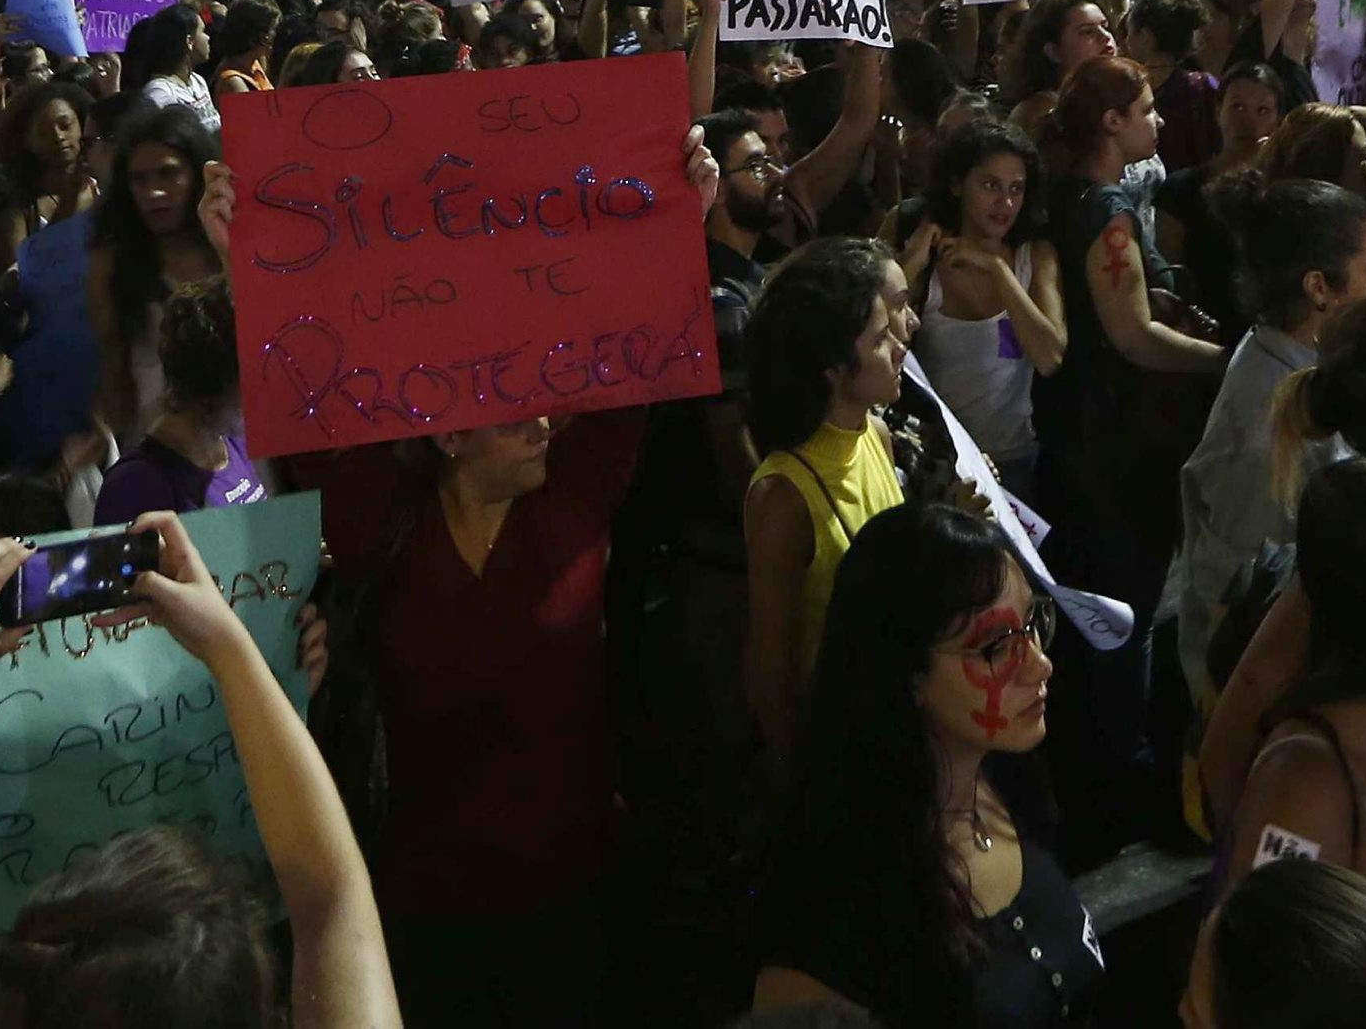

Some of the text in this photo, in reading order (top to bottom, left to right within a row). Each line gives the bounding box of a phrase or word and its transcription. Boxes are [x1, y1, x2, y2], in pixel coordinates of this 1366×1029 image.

[478, 93, 581, 132] SEU
[351, 257, 589, 323] NÃO TE
[98, 730, 239, 810] RESP
